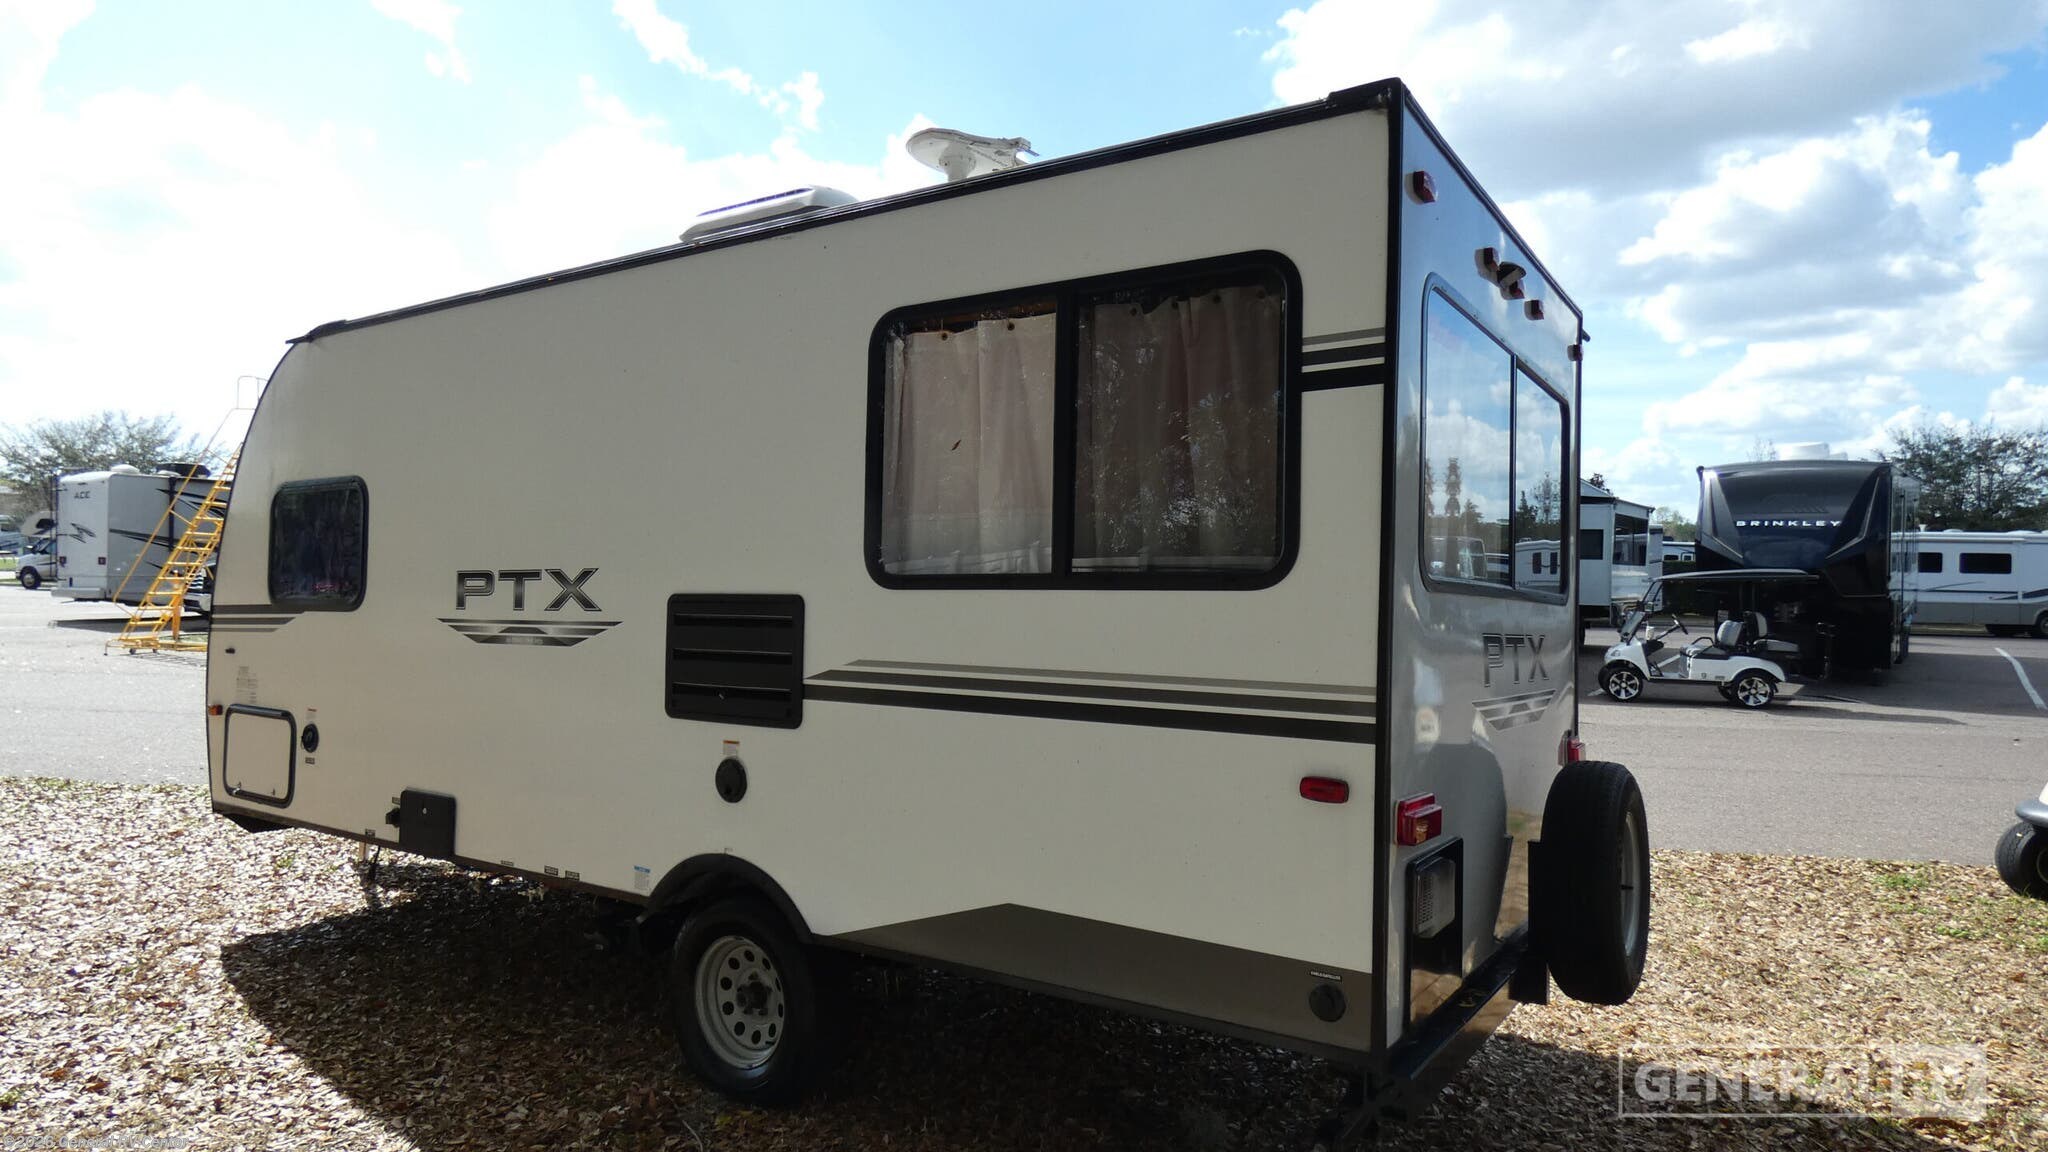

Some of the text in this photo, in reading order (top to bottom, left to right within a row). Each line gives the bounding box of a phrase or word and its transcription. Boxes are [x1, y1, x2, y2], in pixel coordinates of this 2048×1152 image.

[74, 491, 91, 499] ACE
[1736, 519, 1841, 528] BRINKLEY
[456, 568, 602, 611] PTX
[1482, 633, 1549, 688] PTX
